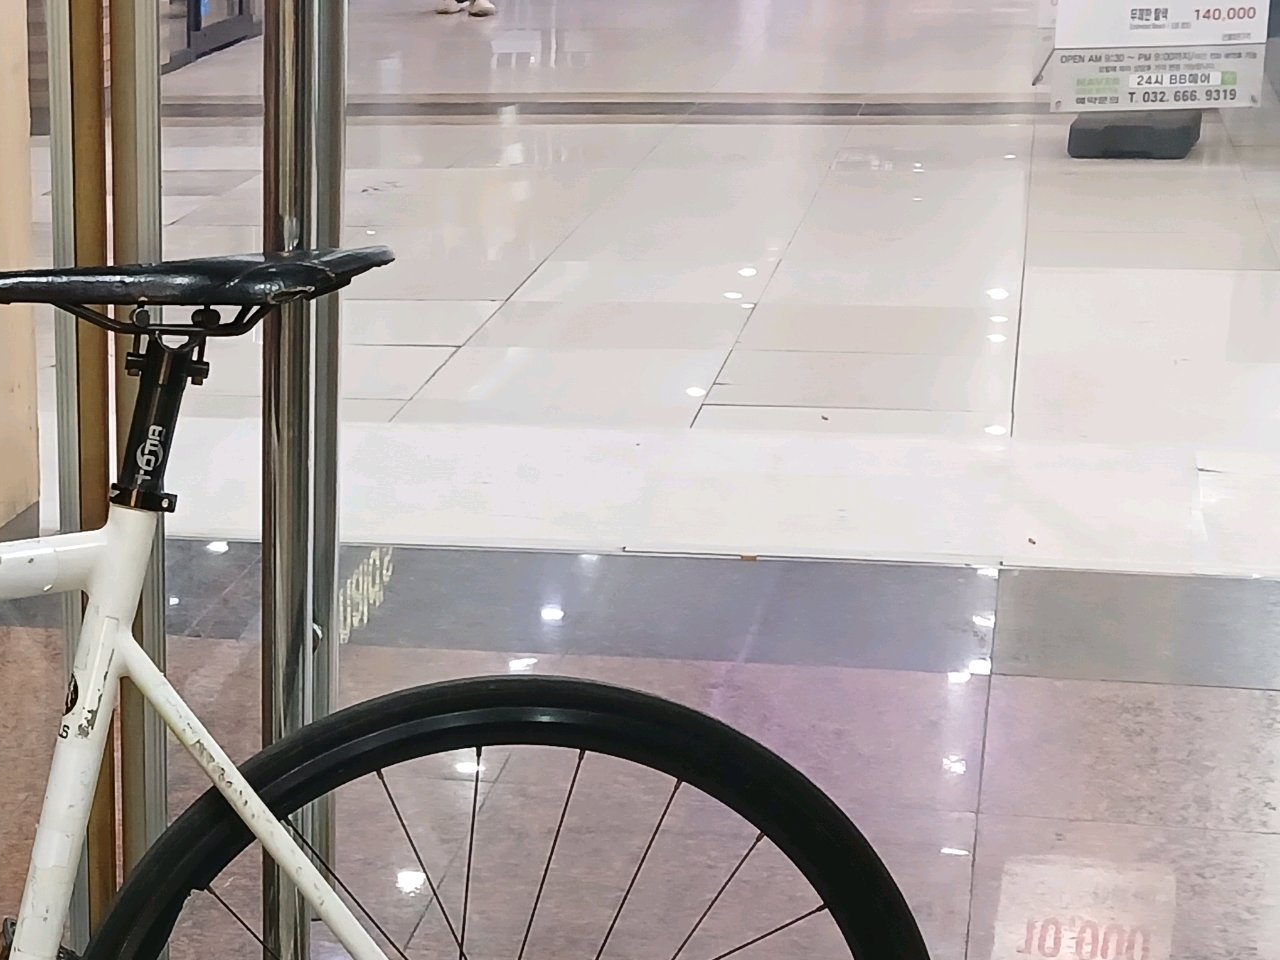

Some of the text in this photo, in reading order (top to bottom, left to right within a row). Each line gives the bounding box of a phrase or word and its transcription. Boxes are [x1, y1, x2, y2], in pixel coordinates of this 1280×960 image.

[1060, 55, 1085, 63] OPEN
[1138, 53, 1151, 61] PM
[1136, 74, 1163, 86] 24시
[1205, 89, 1237, 101] 9319
